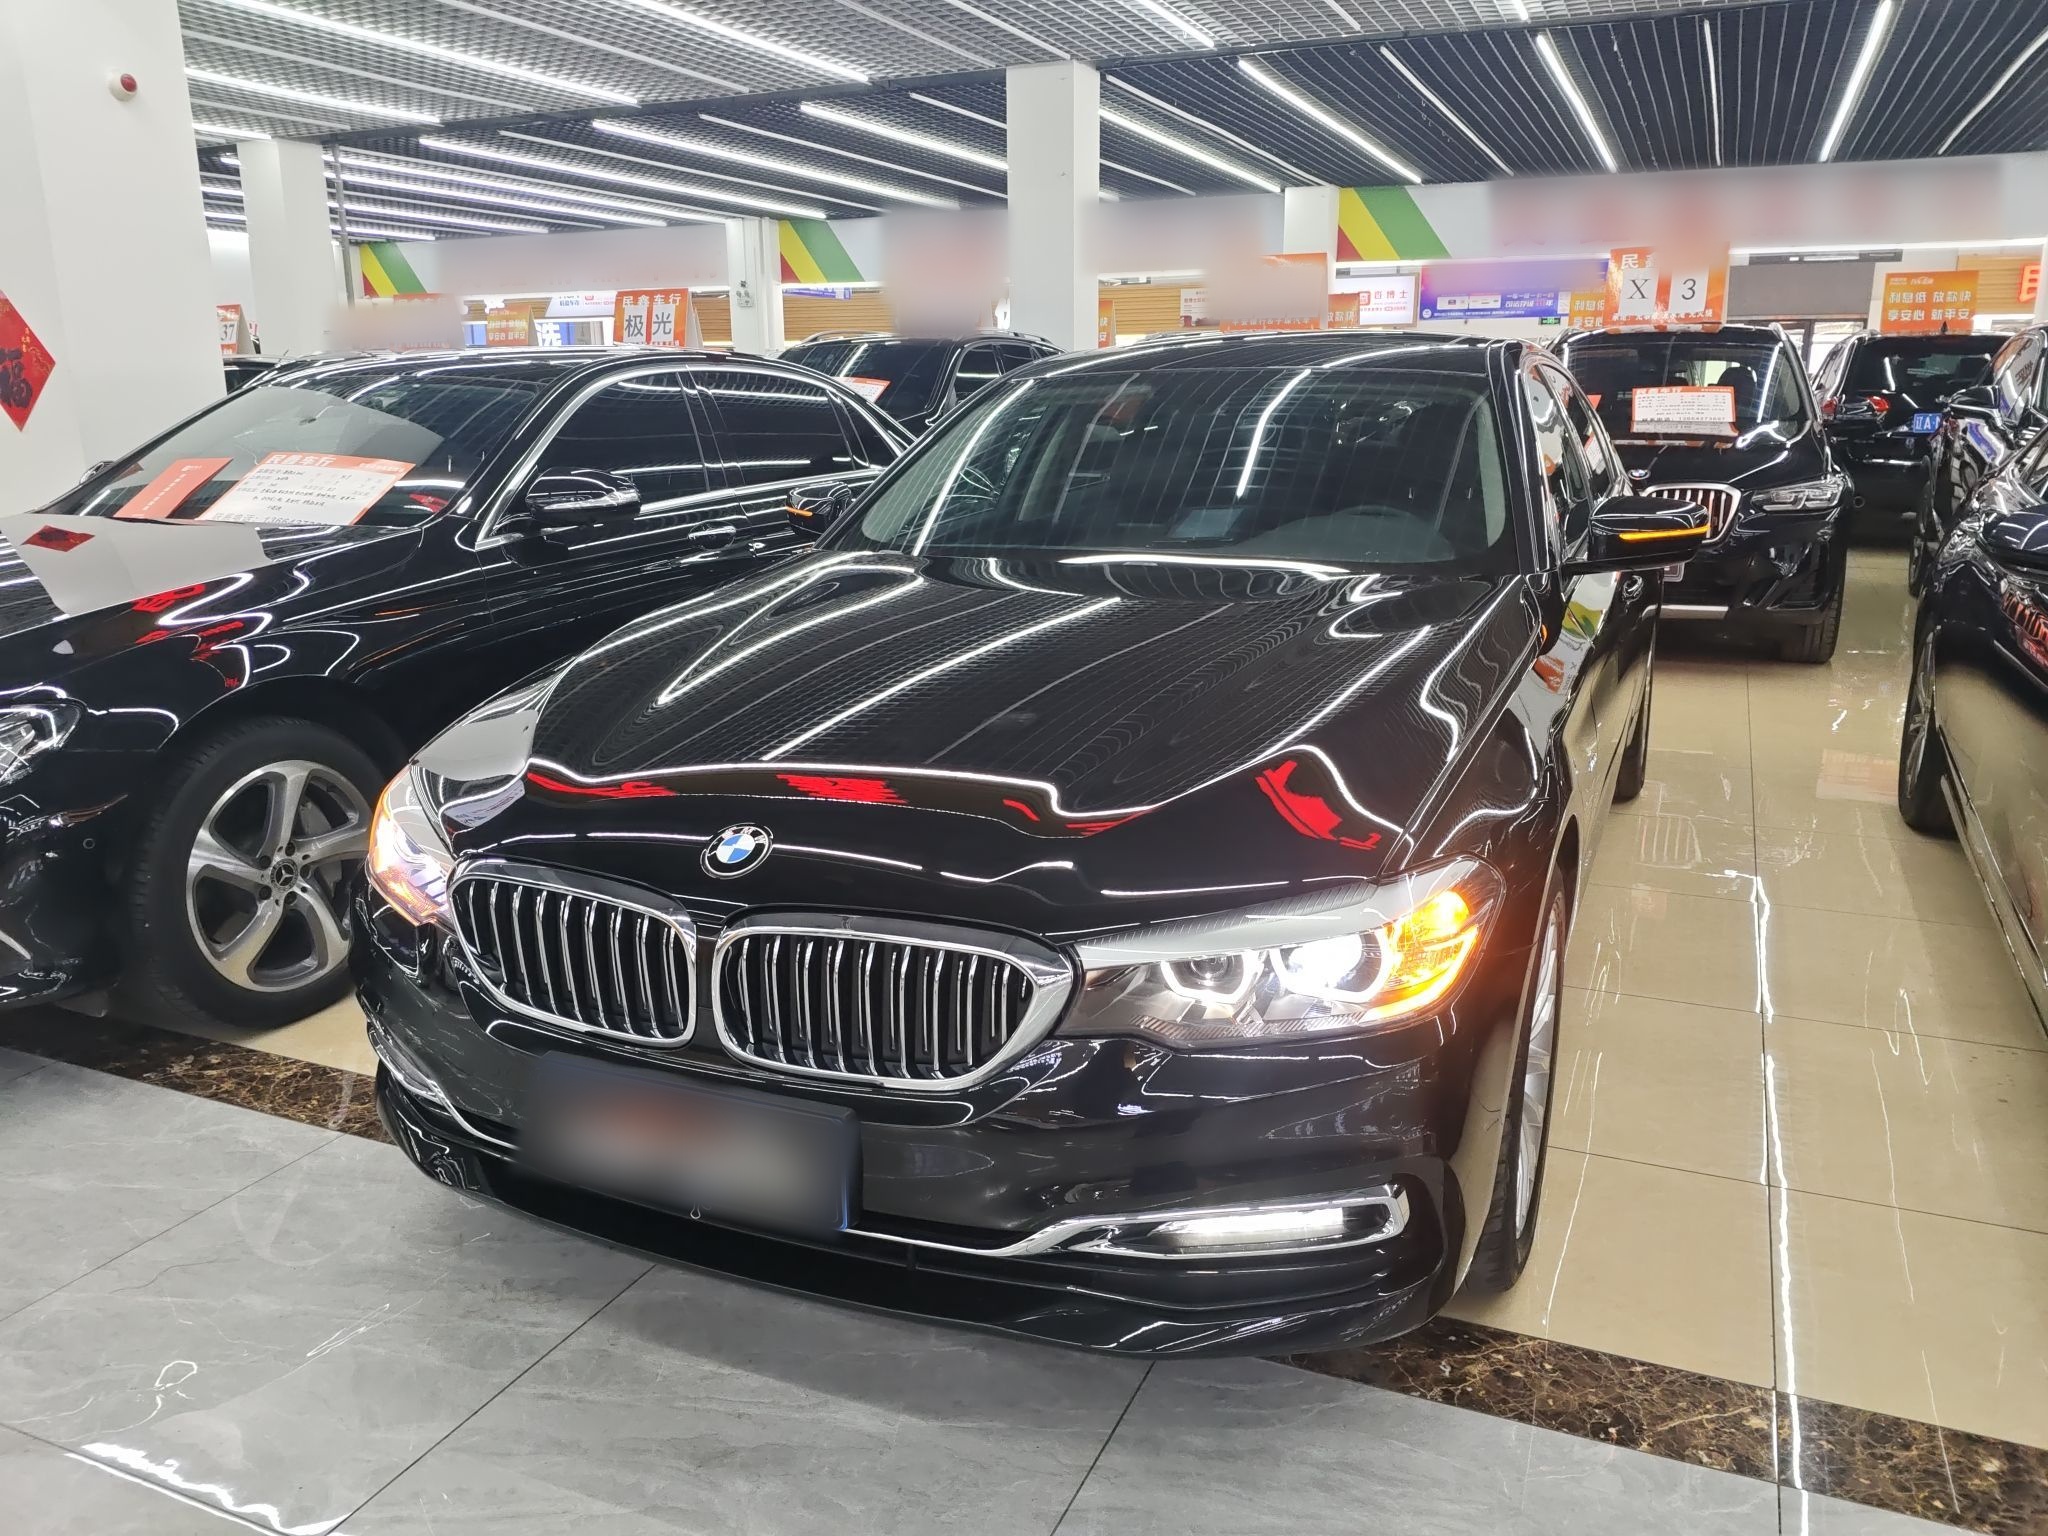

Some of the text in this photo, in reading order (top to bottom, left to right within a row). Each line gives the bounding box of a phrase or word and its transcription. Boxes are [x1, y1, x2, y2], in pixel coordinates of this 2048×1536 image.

[1627, 278, 1697, 300] X 3
[624, 312, 673, 338] 极光
